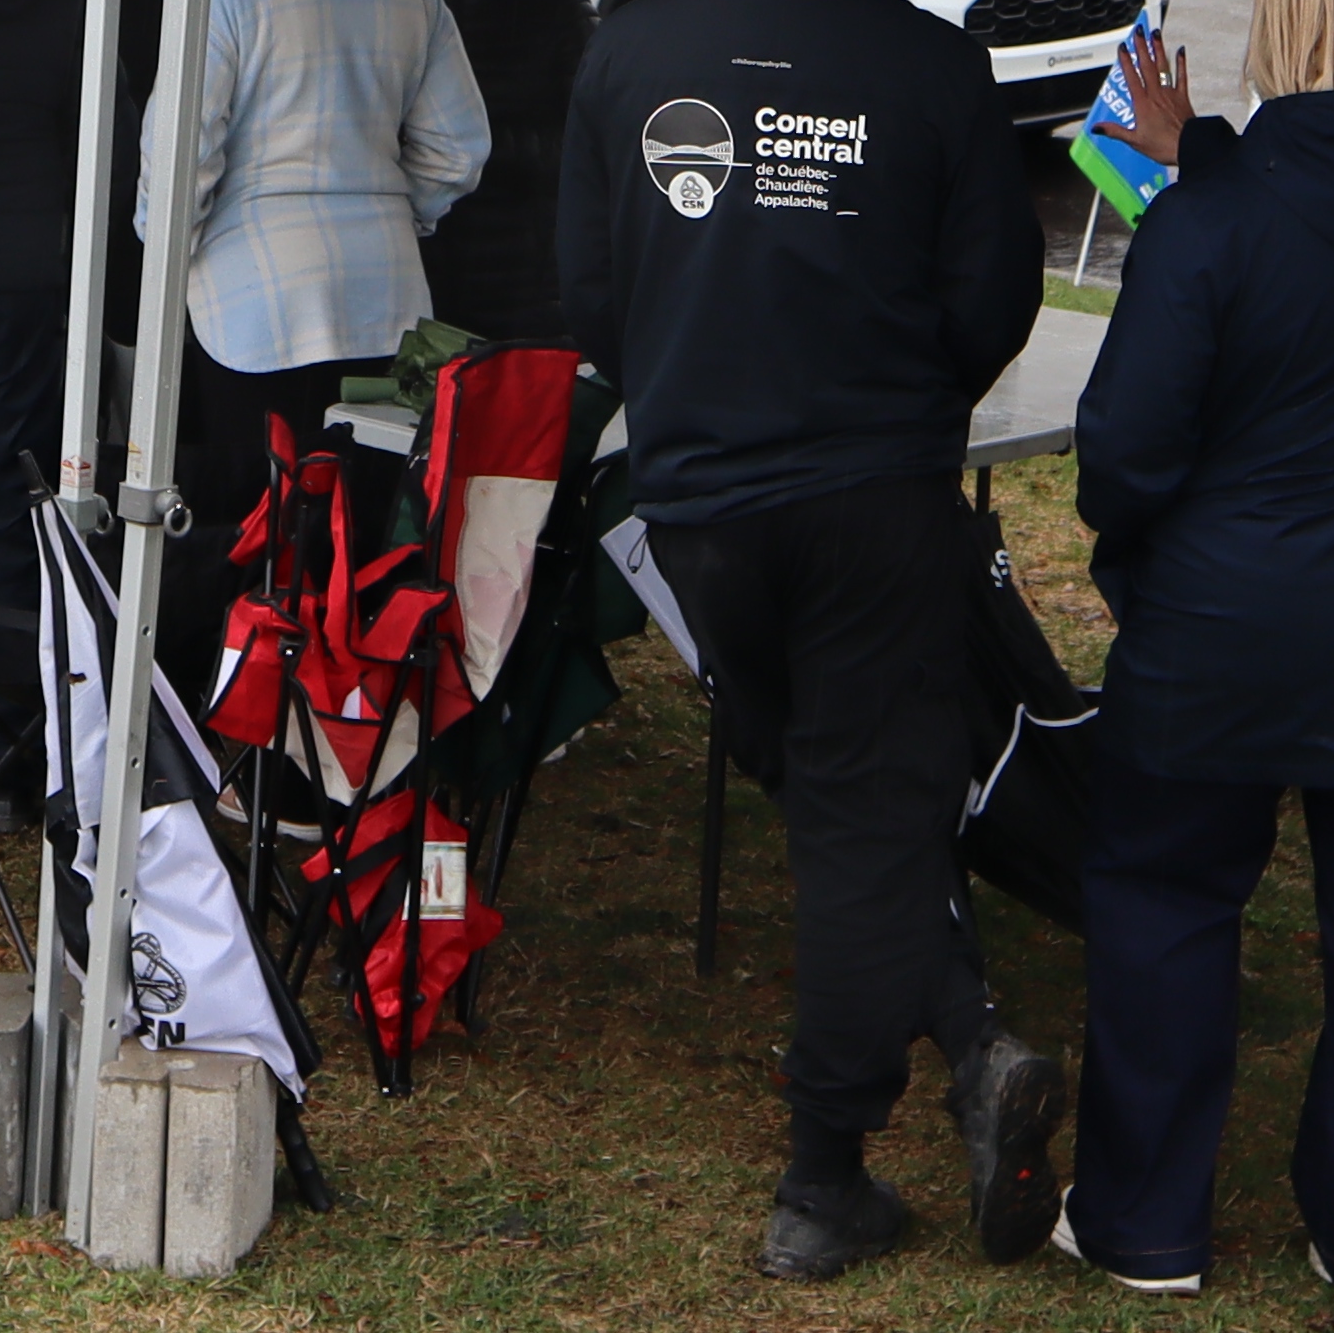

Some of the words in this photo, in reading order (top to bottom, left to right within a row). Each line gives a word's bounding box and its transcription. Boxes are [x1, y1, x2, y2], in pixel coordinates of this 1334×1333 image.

[754, 106, 869, 141] Conseil
[755, 136, 865, 165] central
[756, 163, 775, 176] de
[682, 199, 705, 210] CSN
[754, 192, 829, 211] Appalaches
